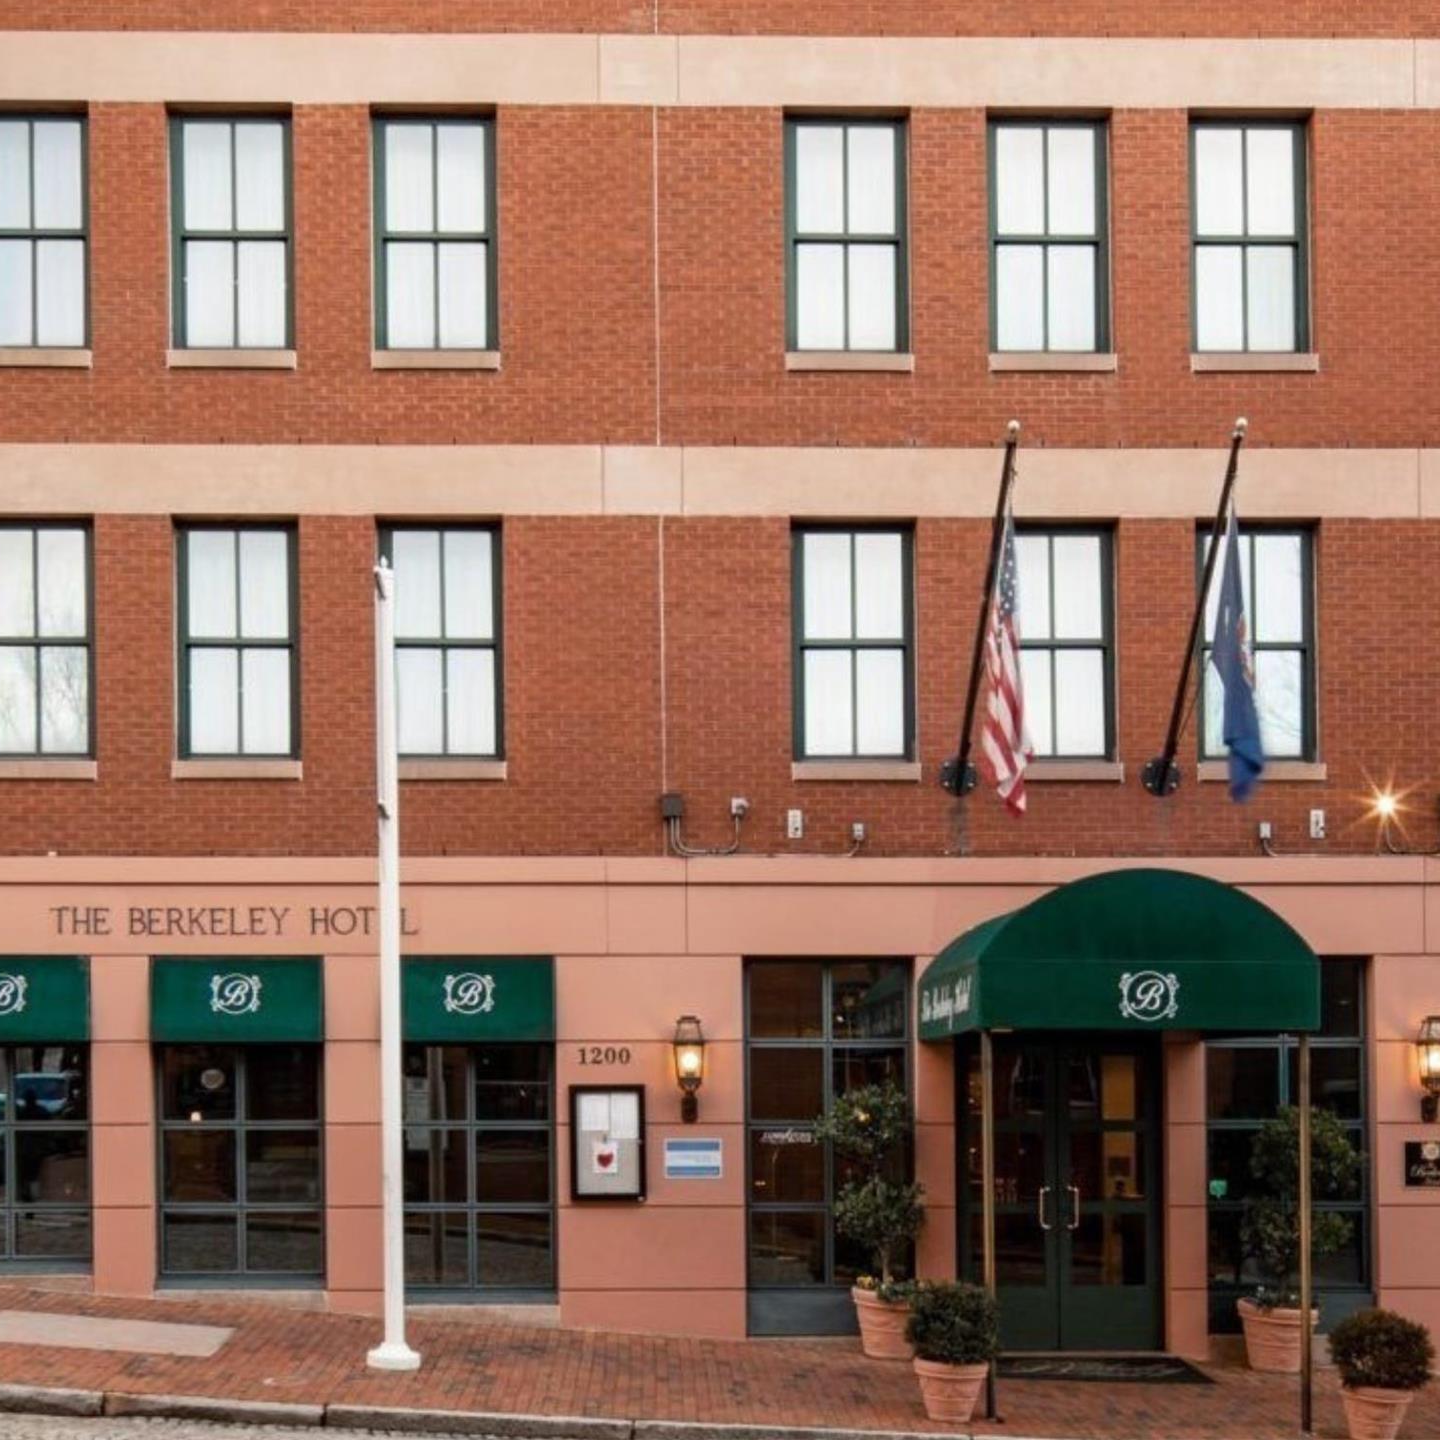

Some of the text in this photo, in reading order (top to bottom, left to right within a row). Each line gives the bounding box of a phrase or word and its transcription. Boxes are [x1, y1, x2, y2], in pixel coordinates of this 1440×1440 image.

[50, 906, 420, 936] THE BERKELEY HOTL
[578, 1047, 631, 1065] 1200
